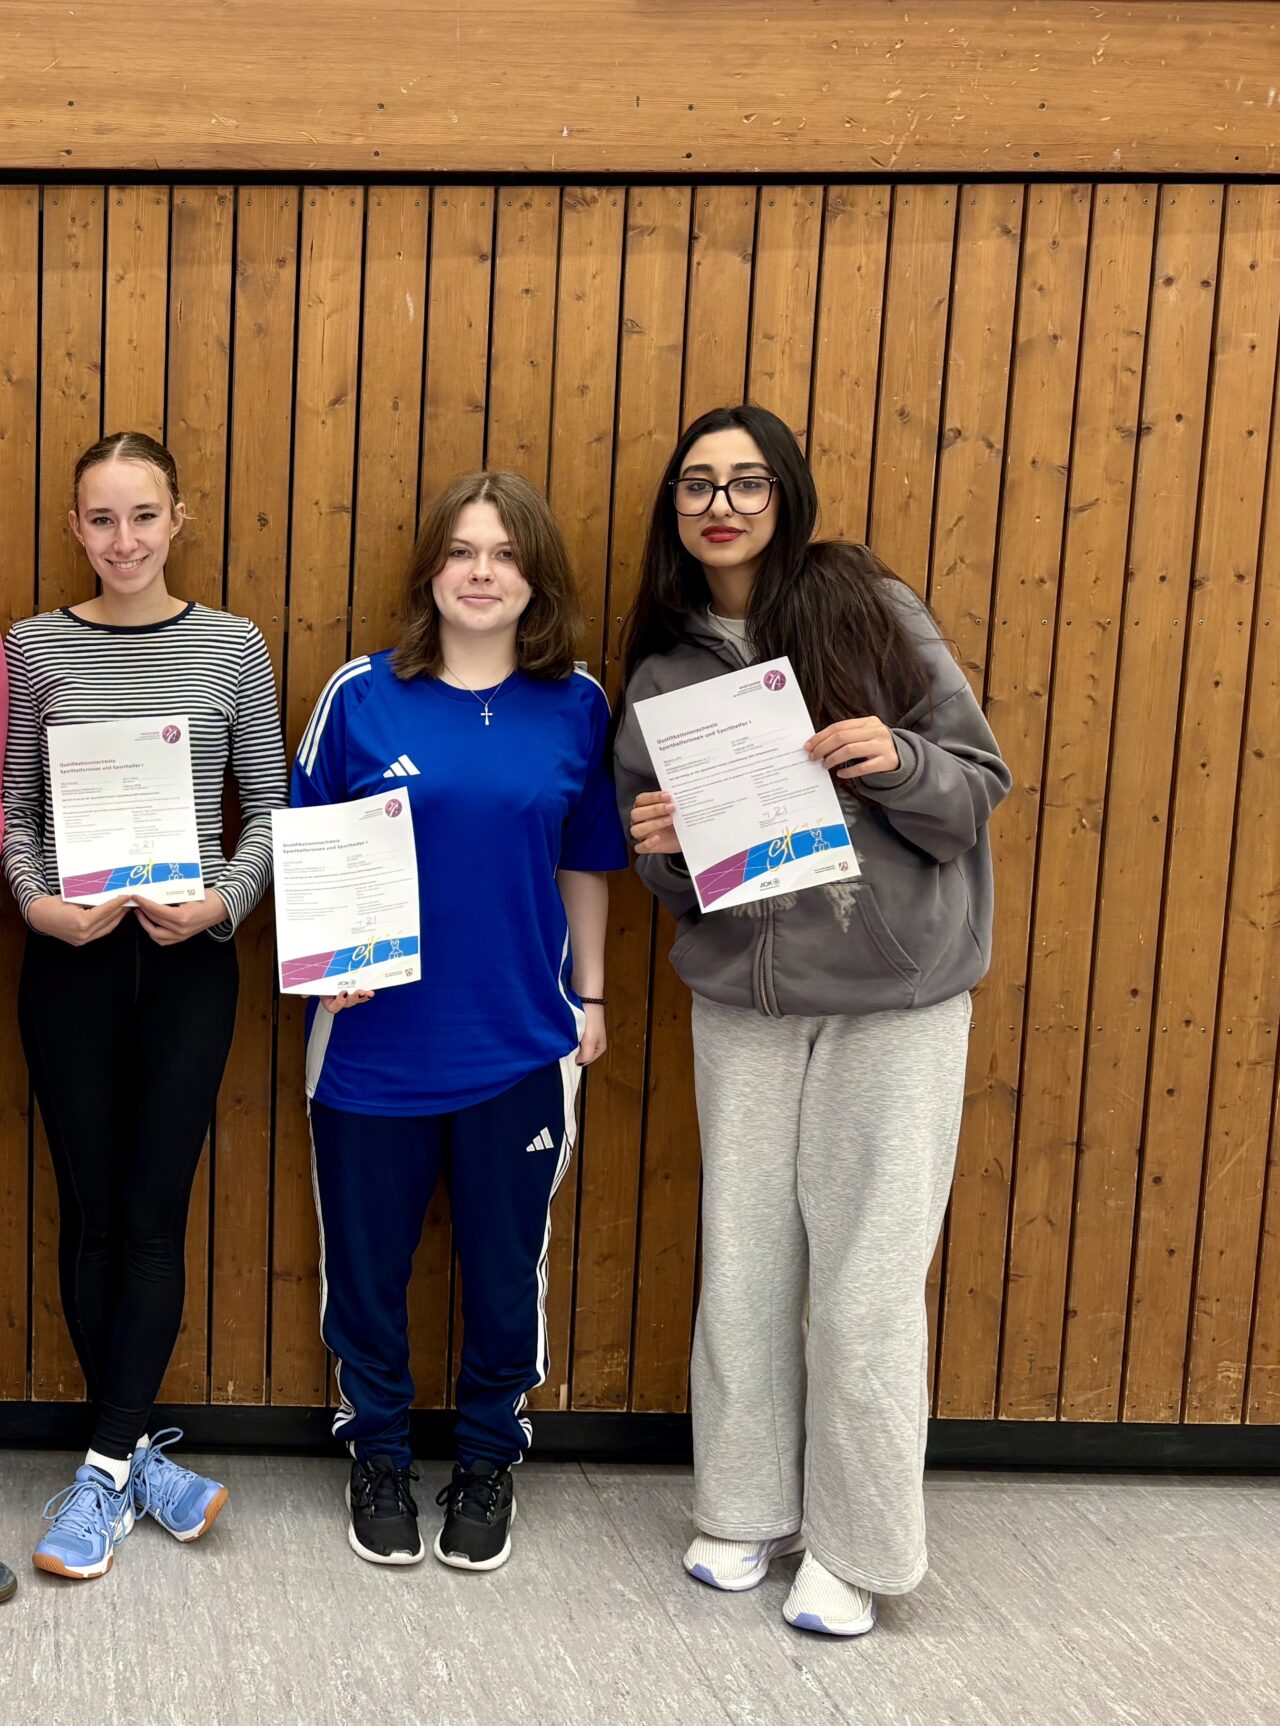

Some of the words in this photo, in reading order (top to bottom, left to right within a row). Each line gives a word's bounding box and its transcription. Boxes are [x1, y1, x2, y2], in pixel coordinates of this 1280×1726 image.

[656, 722, 718, 745] Qualifikationsnachweis
[658, 734, 704, 752] Sporthelferinnen
[716, 721, 748, 736] Sporthelfer
